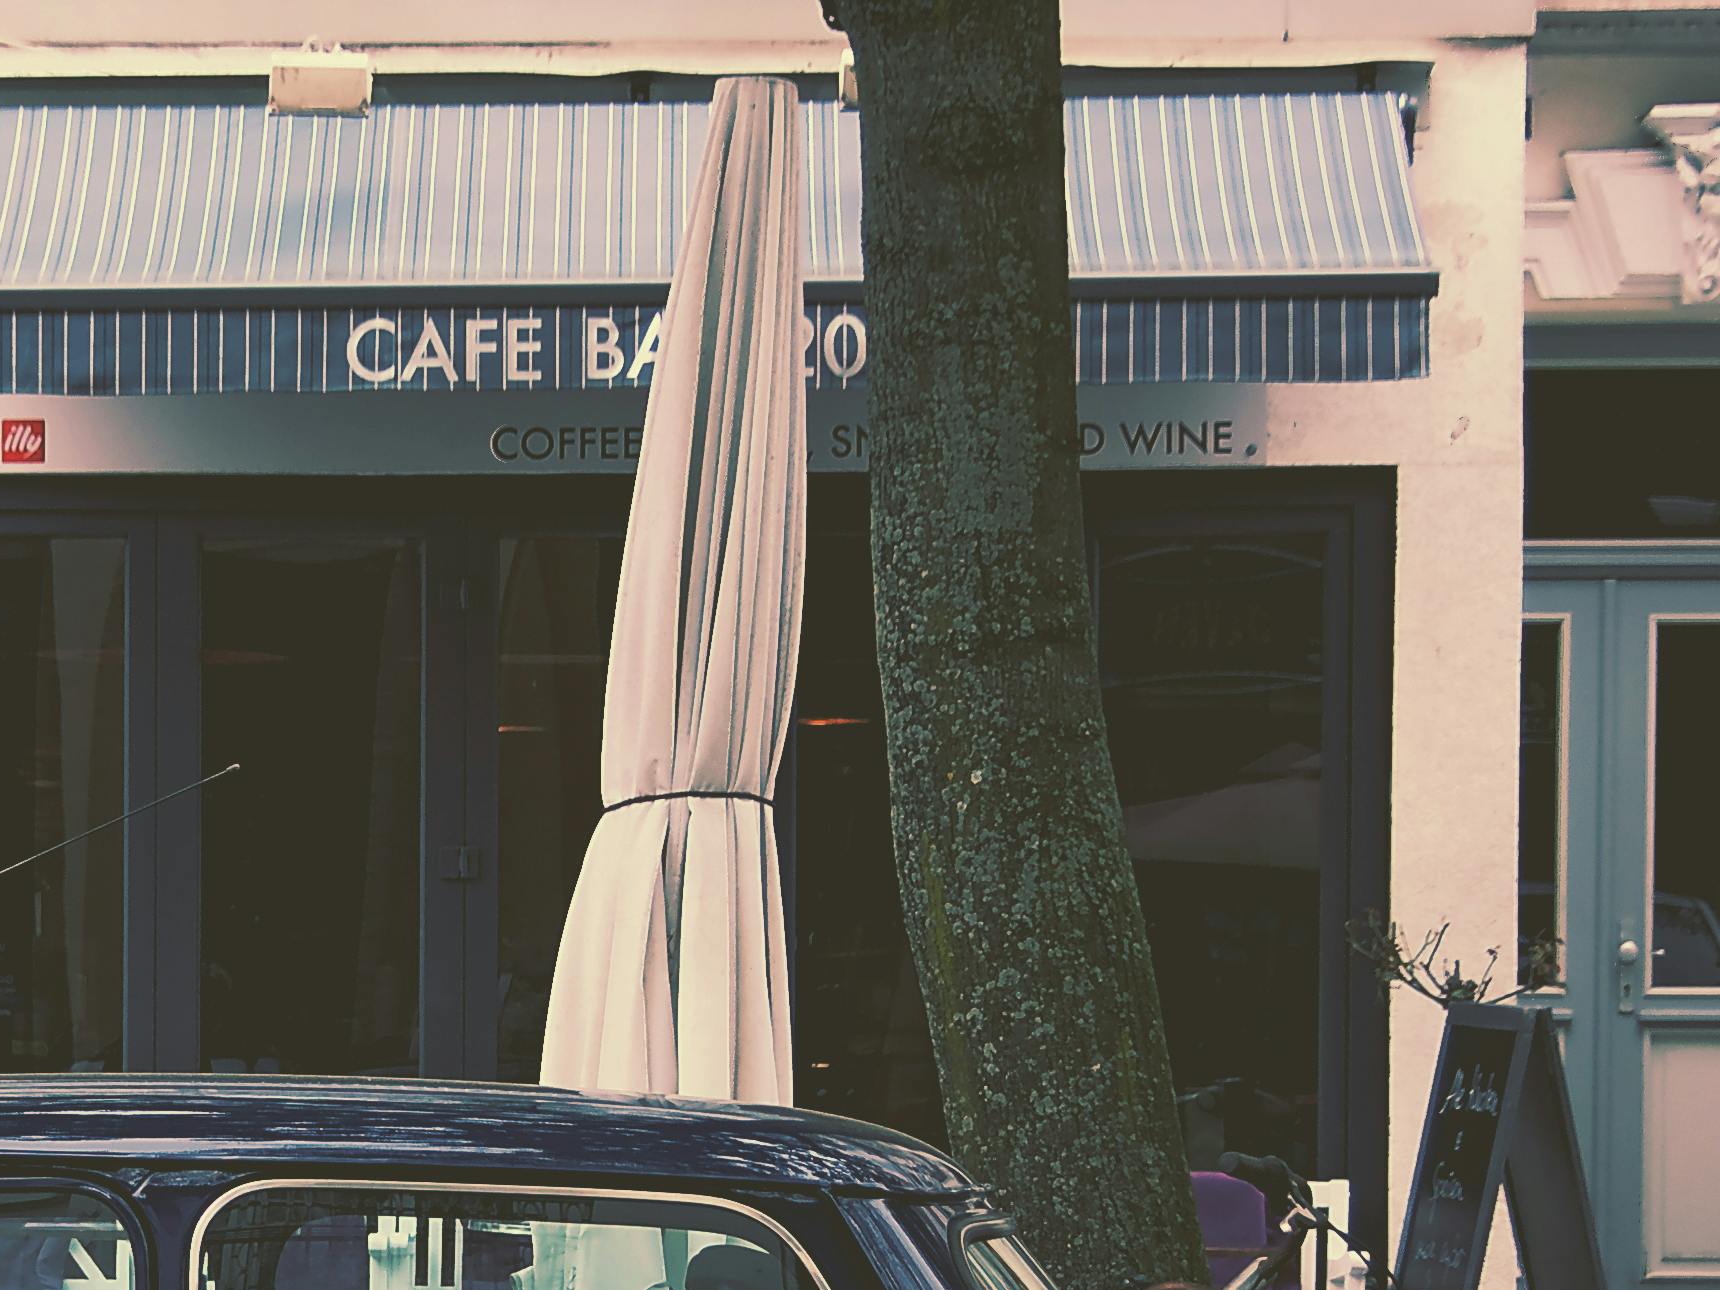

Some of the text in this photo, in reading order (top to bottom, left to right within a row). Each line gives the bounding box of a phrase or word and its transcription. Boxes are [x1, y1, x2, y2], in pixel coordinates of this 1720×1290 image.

[346, 317, 542, 382] CAFE
[587, 312, 661, 380] BA
[4, 424, 42, 459] illy
[491, 425, 641, 462] COFFEE
[1119, 420, 1232, 456] WINE
